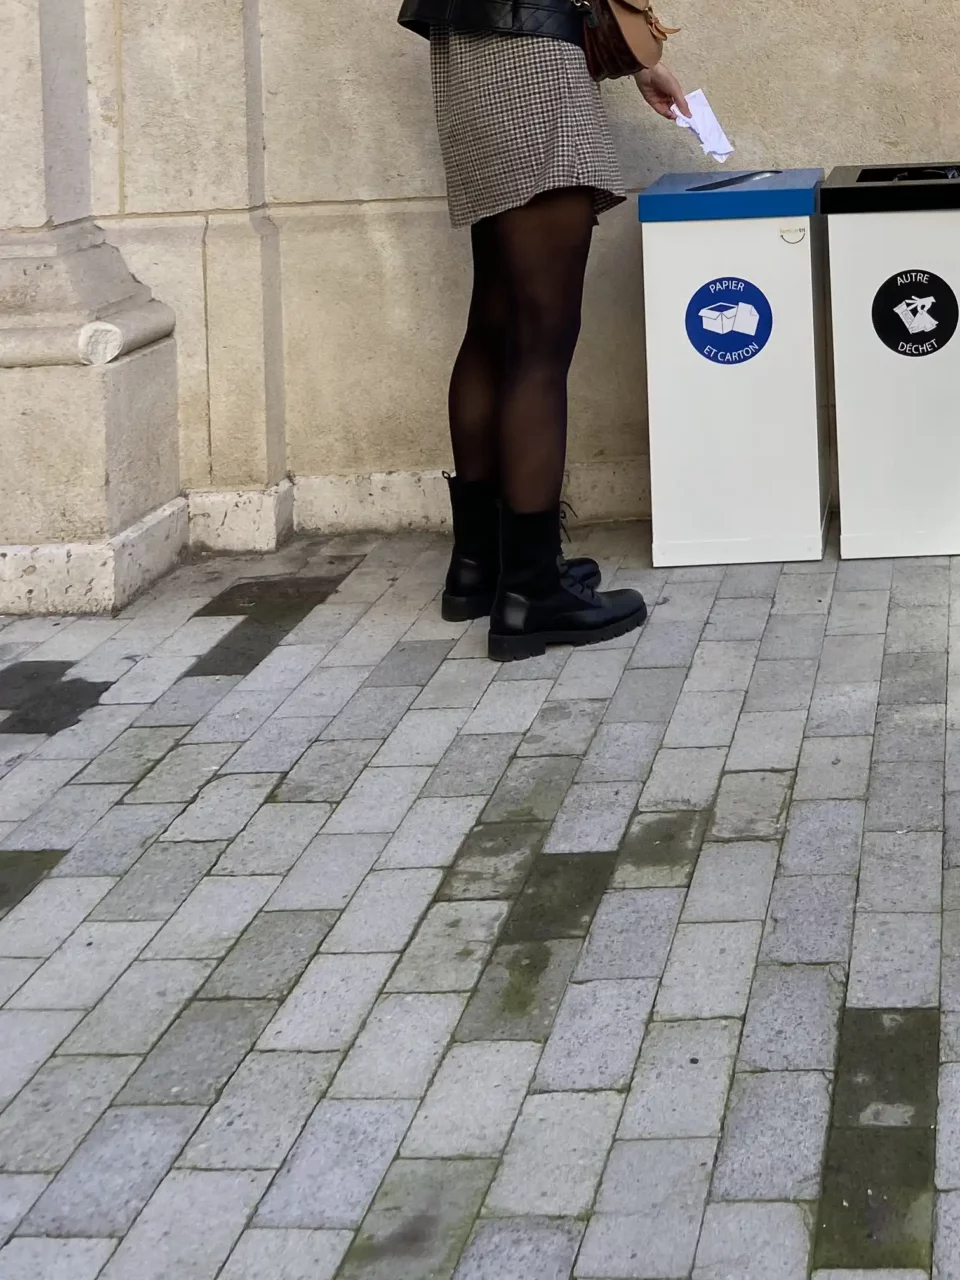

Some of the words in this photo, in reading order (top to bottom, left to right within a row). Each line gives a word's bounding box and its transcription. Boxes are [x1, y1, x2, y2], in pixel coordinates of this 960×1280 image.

[708, 280, 745, 294] PAPIER
[897, 272, 930, 287] AUTRE
[703, 344, 718, 358] ET
[717, 341, 759, 362] CARTON
[897, 338, 938, 355] DÉCHET
